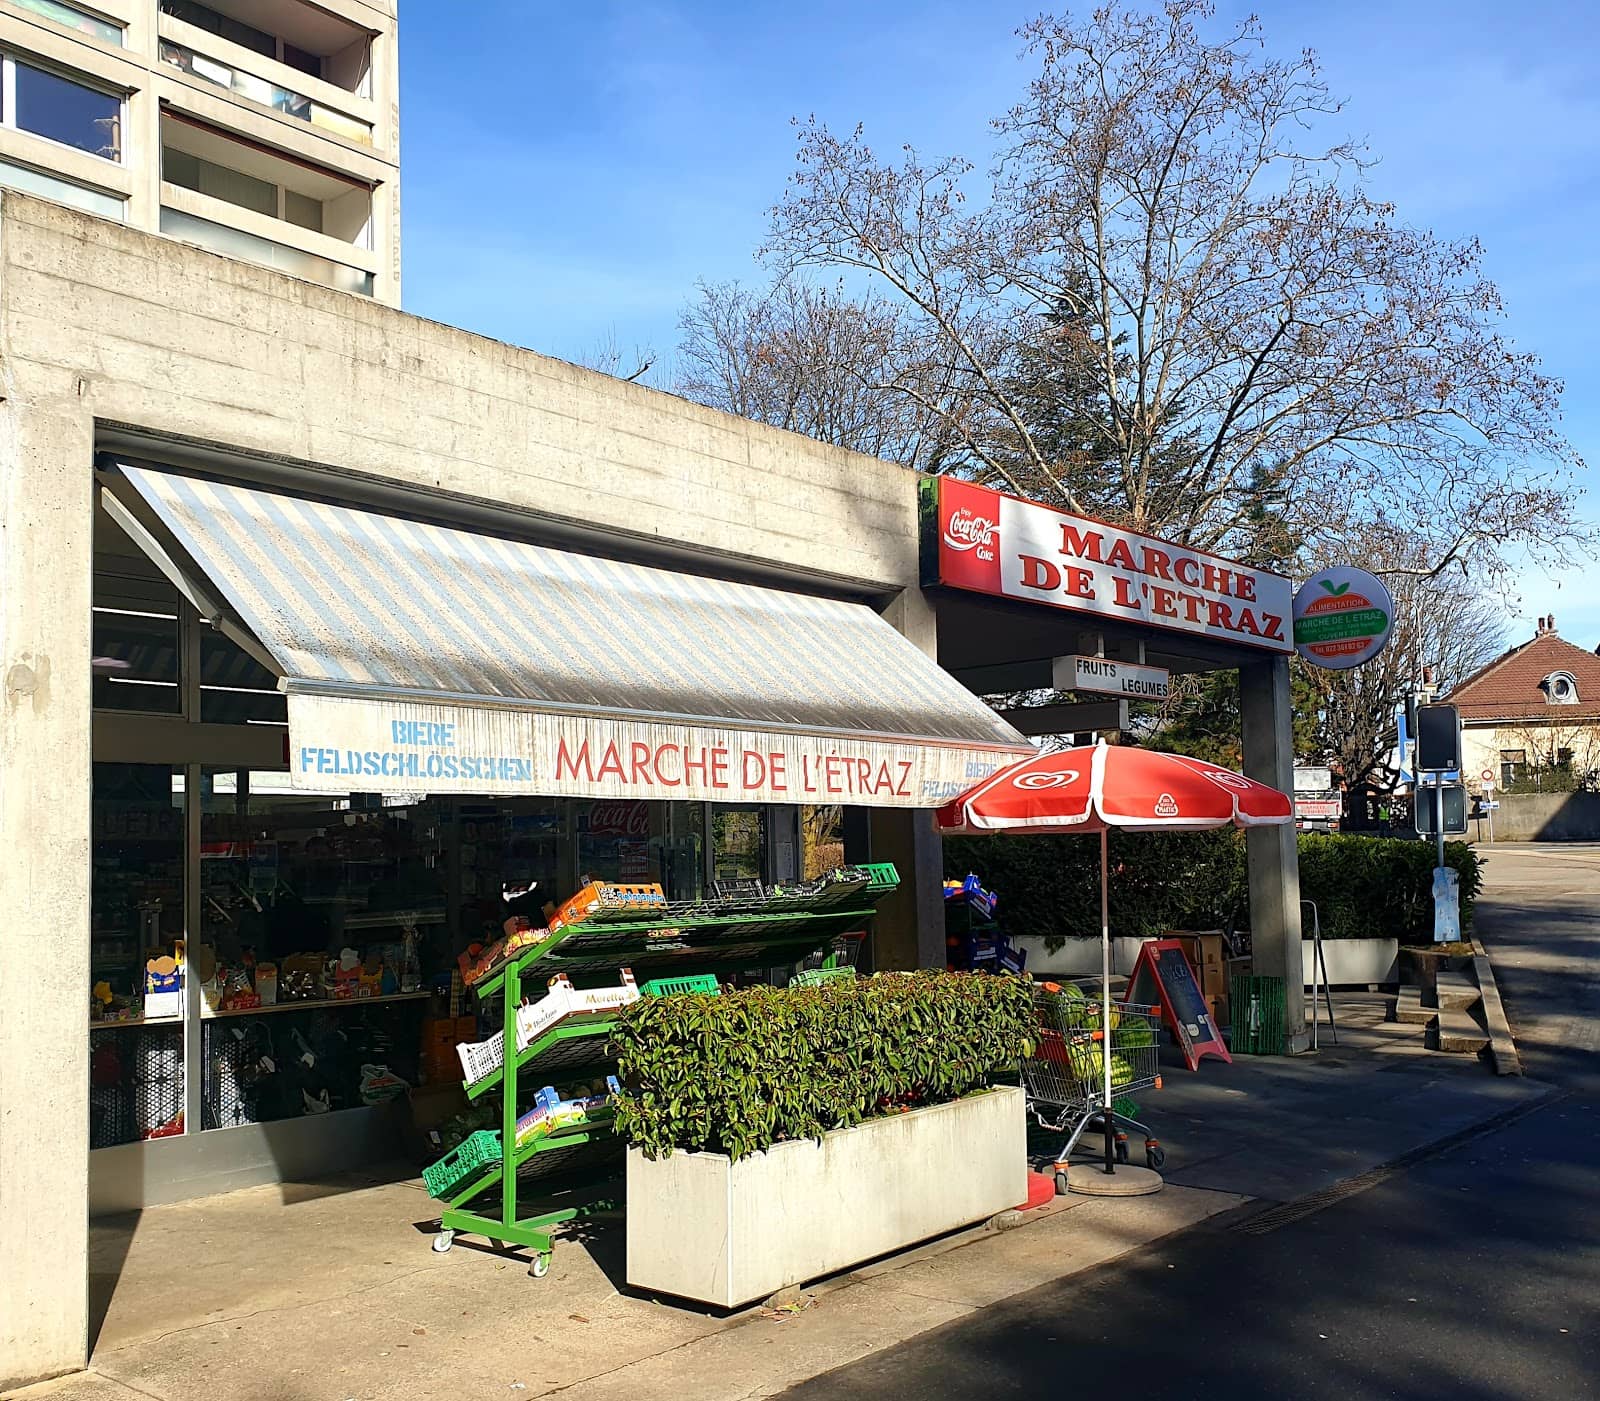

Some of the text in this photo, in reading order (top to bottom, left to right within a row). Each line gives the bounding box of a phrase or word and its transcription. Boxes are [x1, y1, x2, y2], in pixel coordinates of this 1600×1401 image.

[950, 511, 993, 546] Coca-Cola
[976, 546, 994, 561] Coke
[1058, 523, 1257, 602] MARCHE
[1017, 554, 1285, 642] DE L'ETRAZ
[1309, 599, 1364, 612] ALIMENTATION
[1331, 616, 1344, 624] DE
[1076, 659, 1117, 678] FRUITS
[1121, 678, 1168, 697] LEGUMES
[391, 719, 455, 747] BIERE
[301, 747, 532, 781] FELDSCHLÖSSCHEN
[555, 736, 912, 796] MARCHÉ DE L'ÉTRAZ
